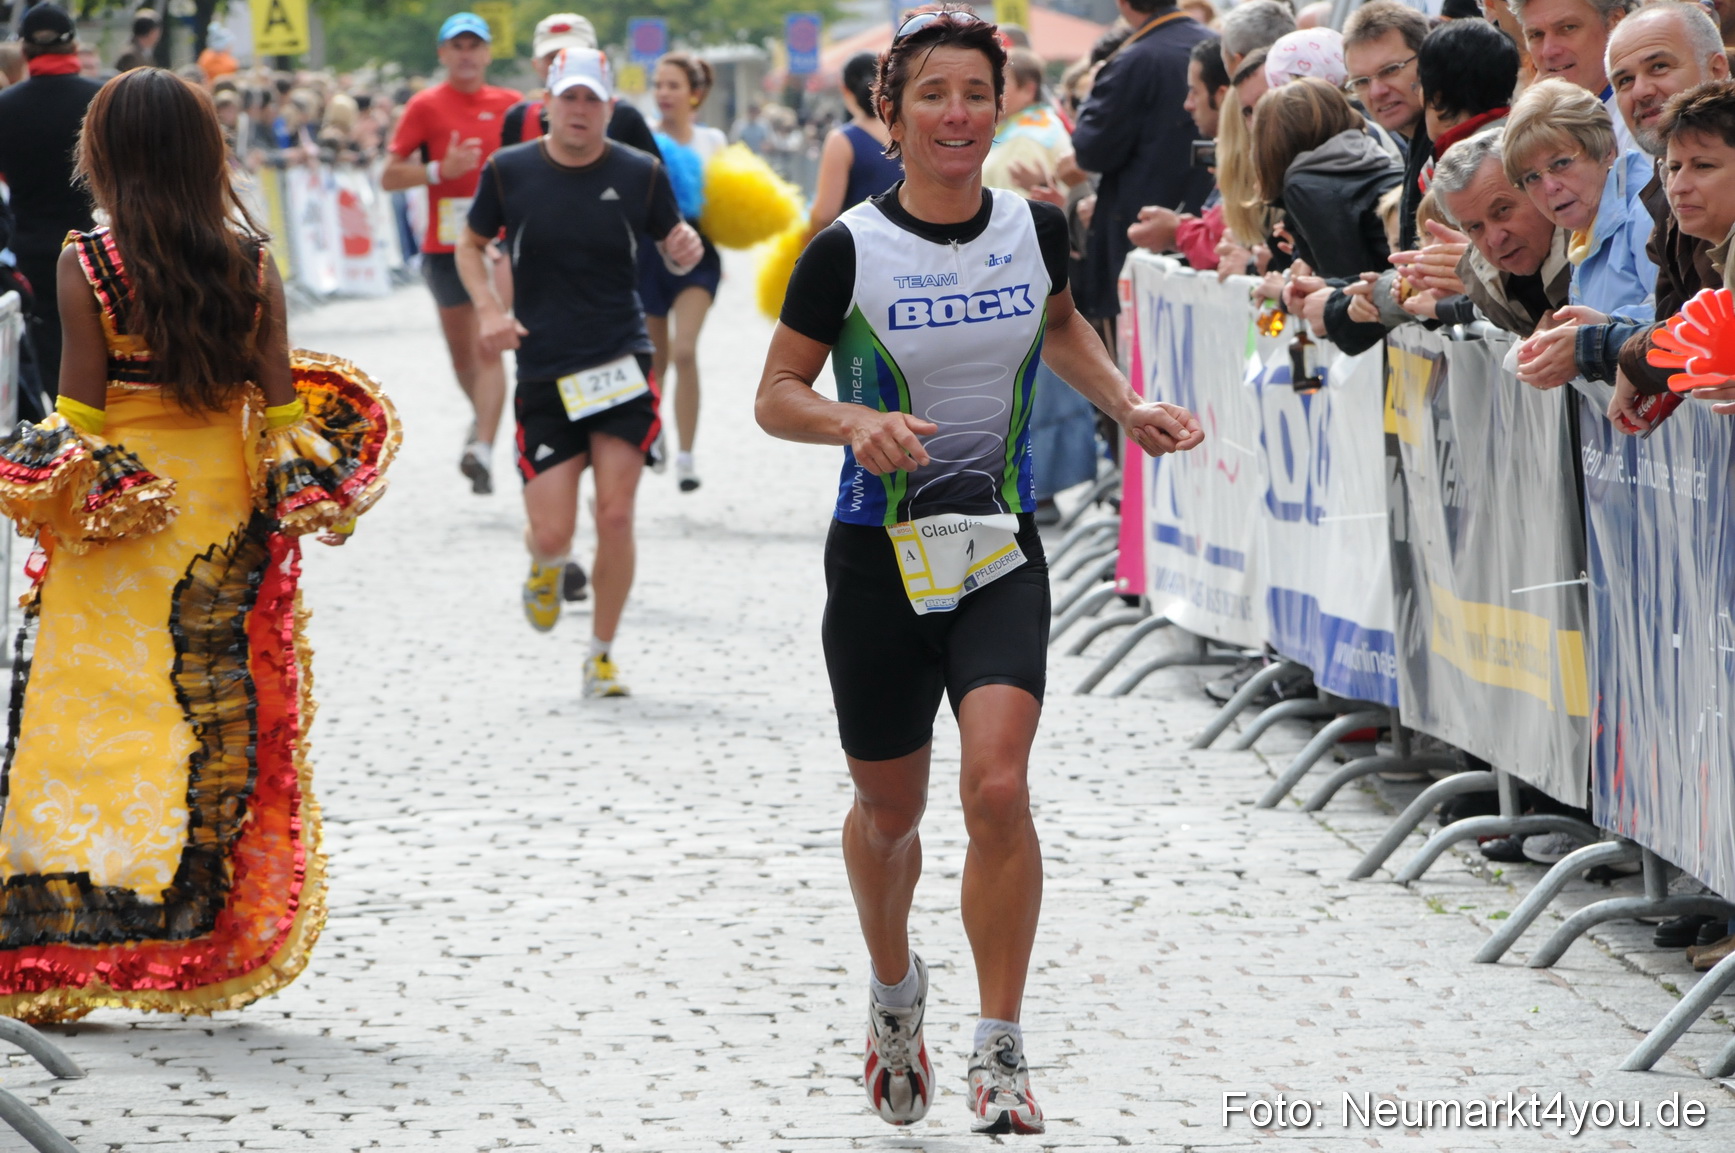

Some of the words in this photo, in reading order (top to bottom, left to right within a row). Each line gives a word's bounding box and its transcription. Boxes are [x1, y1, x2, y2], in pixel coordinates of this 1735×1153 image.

[894, 273, 958, 288] TEAM
[888, 284, 1035, 330] BOCK
[588, 368, 627, 392] 274
[905, 549, 916, 562] A
[974, 549, 1021, 580] PFLEIDERER
